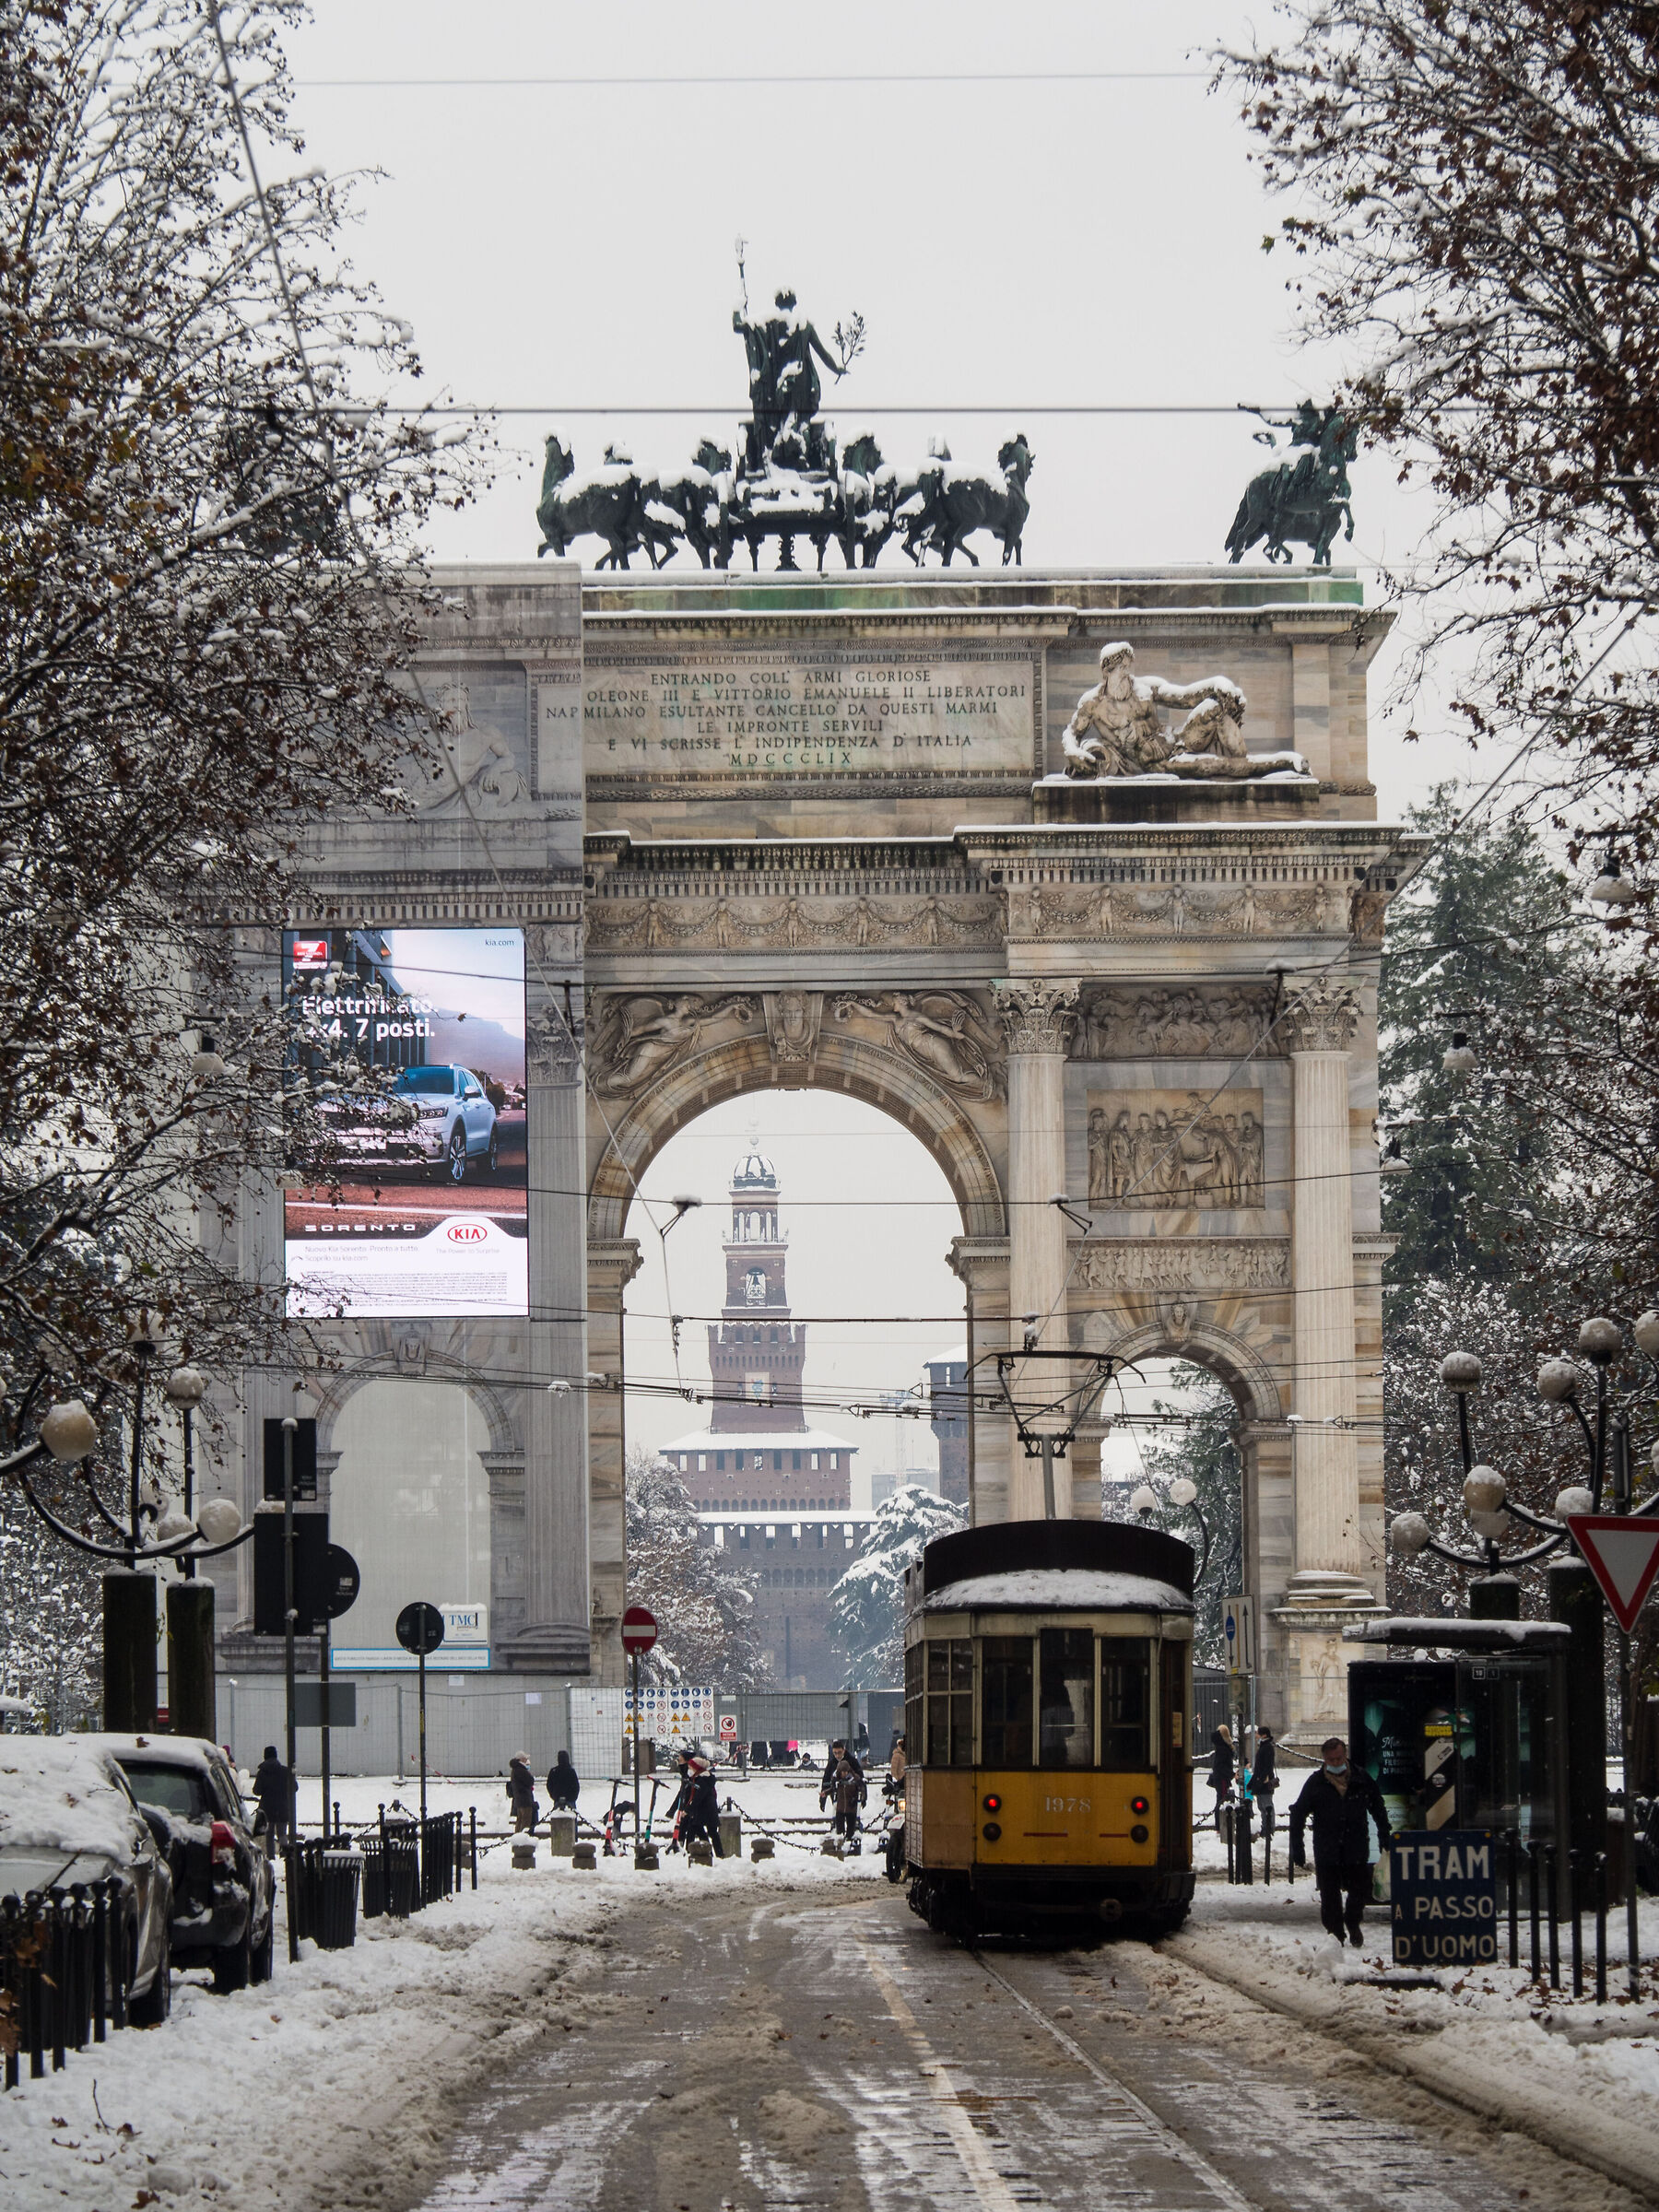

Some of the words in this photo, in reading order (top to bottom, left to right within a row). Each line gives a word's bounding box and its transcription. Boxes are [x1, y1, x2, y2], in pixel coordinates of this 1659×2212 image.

[651, 673, 736, 686] ENTRANDO
[804, 671, 842, 683] ARMI
[855, 670, 931, 682] GLORIOSE
[663, 689, 679, 701] III
[692, 689, 700, 701] E
[713, 688, 791, 700] VITTORIO
[804, 688, 890, 700] EMANUELE
[903, 687, 913, 699] II
[927, 685, 1025, 698] LIBERATORI
[547, 706, 579, 719] NAP
[583, 706, 646, 719] MILANO
[659, 705, 745, 718] ESULTANTE
[847, 704, 867, 716] DA
[879, 702, 935, 716] QUESTI
[946, 701, 997, 714] MARMI
[698, 722, 714, 734] LE
[727, 721, 809, 733] IMPRONTE
[822, 720, 883, 732] SERVILI
[608, 738, 617, 750] E
[630, 738, 647, 750] VI
[660, 737, 722, 750] SCRISSE
[756, 736, 879, 749] INDIPENDENZA
[917, 735, 972, 747] ITALIA
[485, 938, 515, 947] kia.com
[301, 942, 320, 962] 7
[355, 1018, 369, 1038] 7
[376, 1018, 436, 1041] posti.
[304, 1224, 416, 1232] SORENTO
[454, 1229, 481, 1240] KIA
[1044, 1796, 1091, 1813] 1978
[1396, 1845, 1489, 1880] TRAM
[1394, 1902, 1403, 1920] A
[1414, 1895, 1494, 1920] PASSO
[1394, 1935, 1495, 1959] D'UOMO
